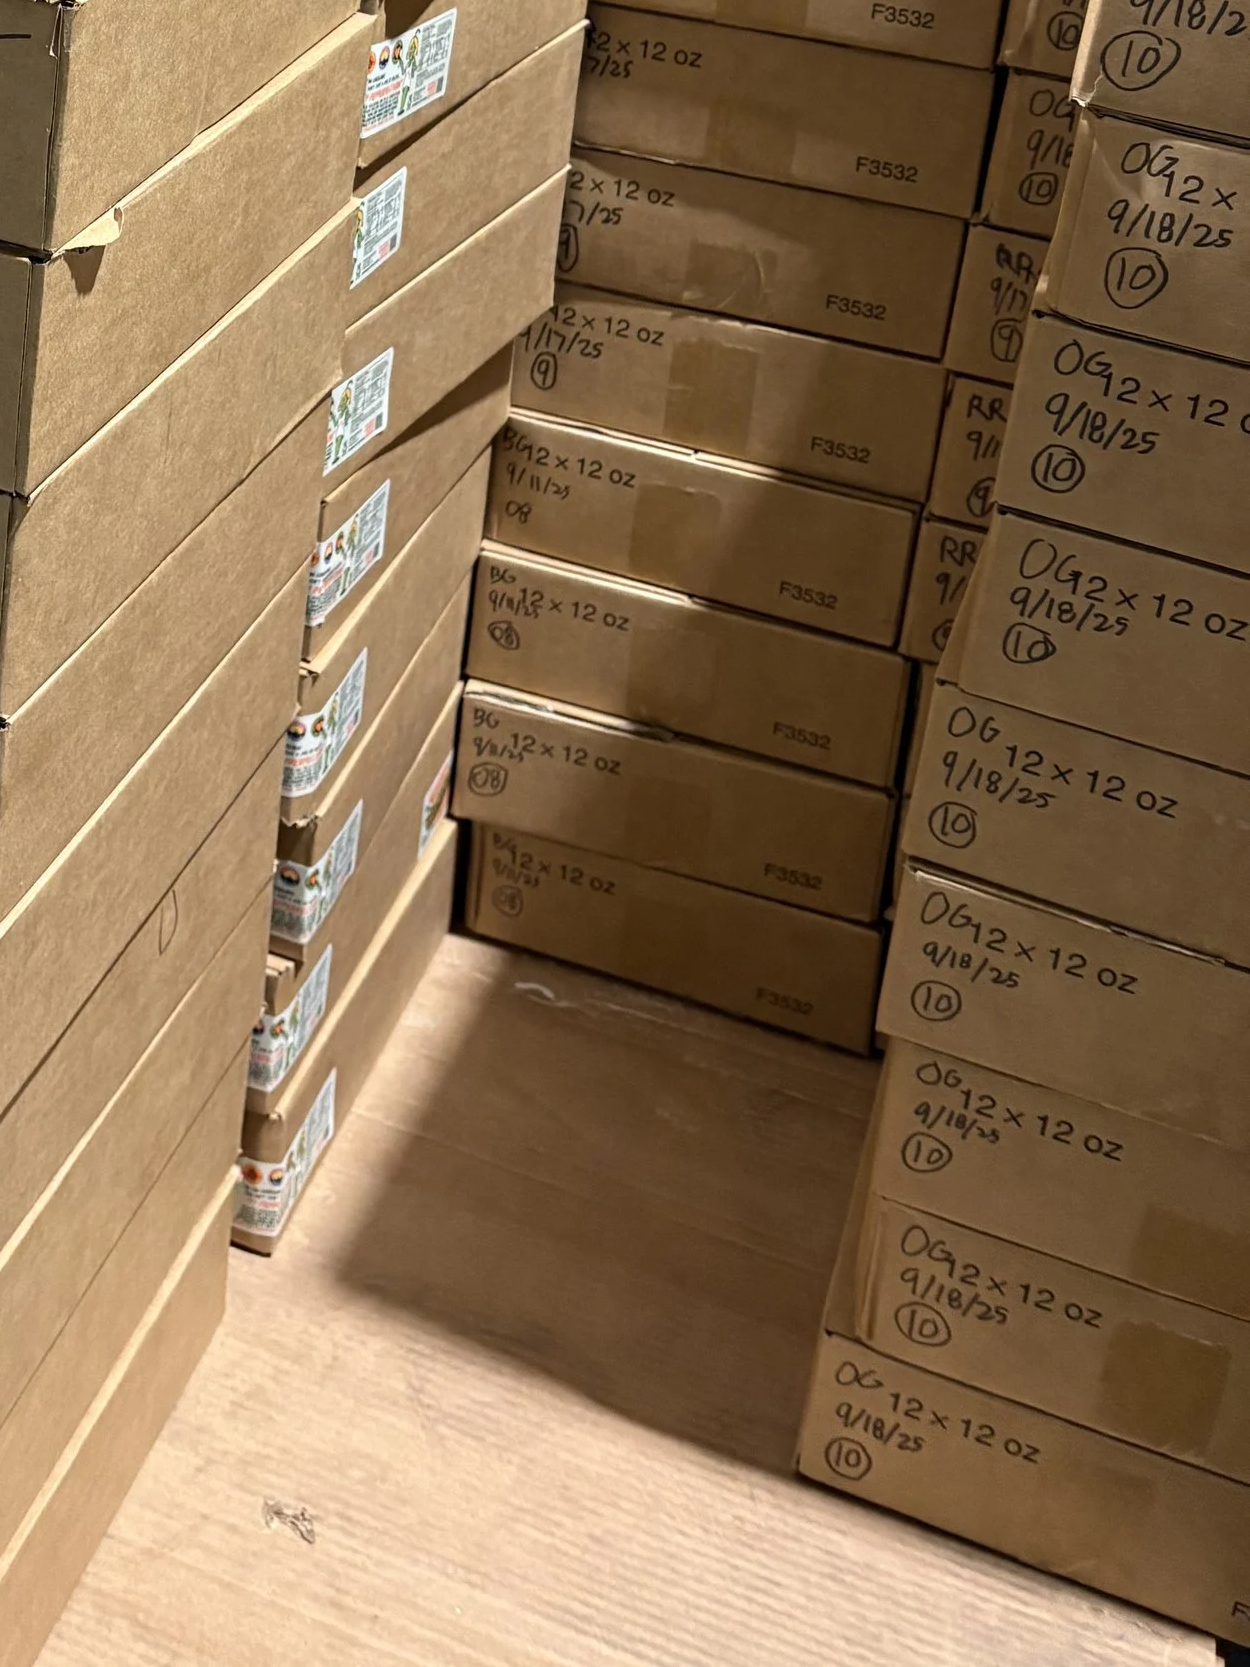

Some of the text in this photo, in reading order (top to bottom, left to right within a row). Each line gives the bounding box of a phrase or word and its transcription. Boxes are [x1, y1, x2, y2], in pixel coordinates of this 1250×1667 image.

[1164, 170, 1238, 211] 12 x
[1107, 199, 1235, 248] 9/18/25
[948, 706, 1001, 743] OG
[941, 750, 1059, 808] 9/18/25
[1004, 744, 1180, 819] 12 x 12 oz
[834, 1361, 884, 1390] OG
[890, 1393, 1041, 1464] 12 x 12 oz
